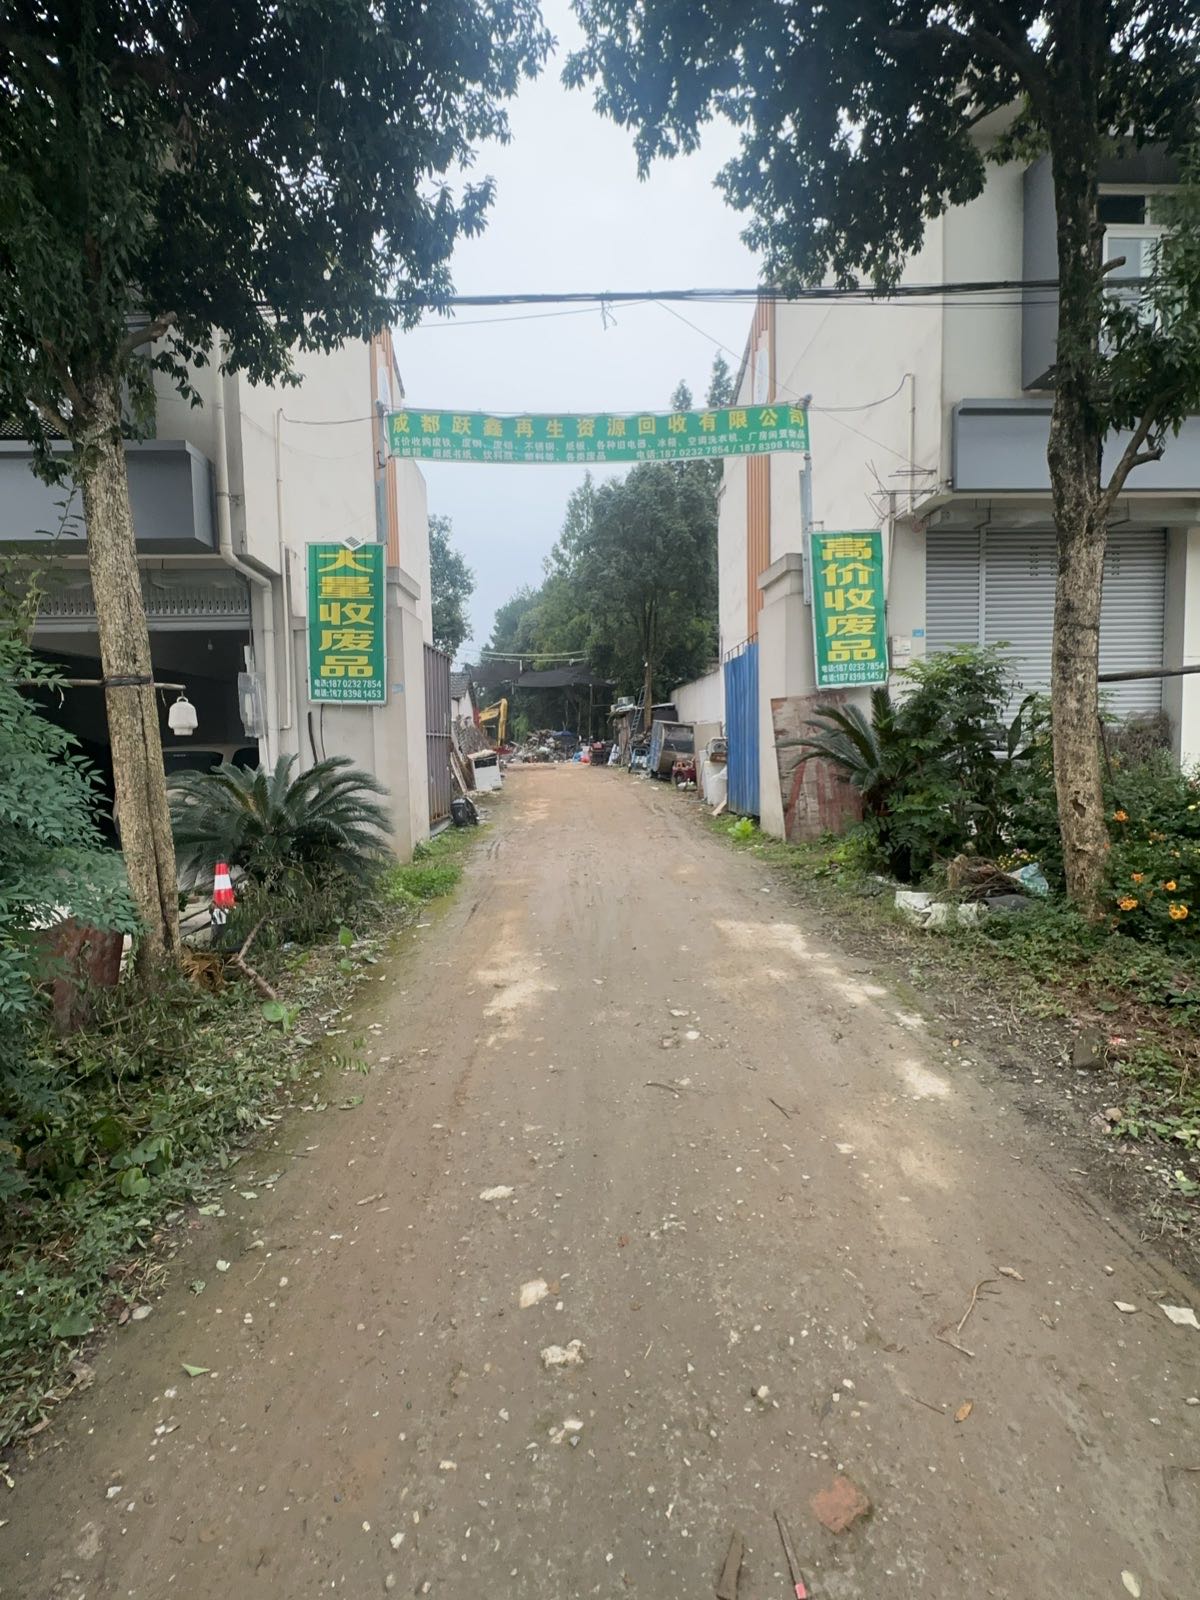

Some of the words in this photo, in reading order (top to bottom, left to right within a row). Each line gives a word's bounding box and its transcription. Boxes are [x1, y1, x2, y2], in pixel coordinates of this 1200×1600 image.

[393, 408, 805, 438] 成都跃鑫再生资源回收有限公司
[679, 448, 703, 457] 0232
[706, 446, 729, 455] 7854
[740, 443, 756, 452] 187
[759, 441, 783, 450] 8398
[785, 440, 805, 449] 1453
[819, 537, 876, 662] 高价收废品
[318, 549, 374, 677] 大量收废品
[849, 663, 865, 672] 0232
[866, 661, 884, 670] 7854
[342, 680, 361, 688] 0232
[363, 680, 381, 688] 7854
[343, 689, 361, 698] 8398
[363, 689, 381, 698] 1453
